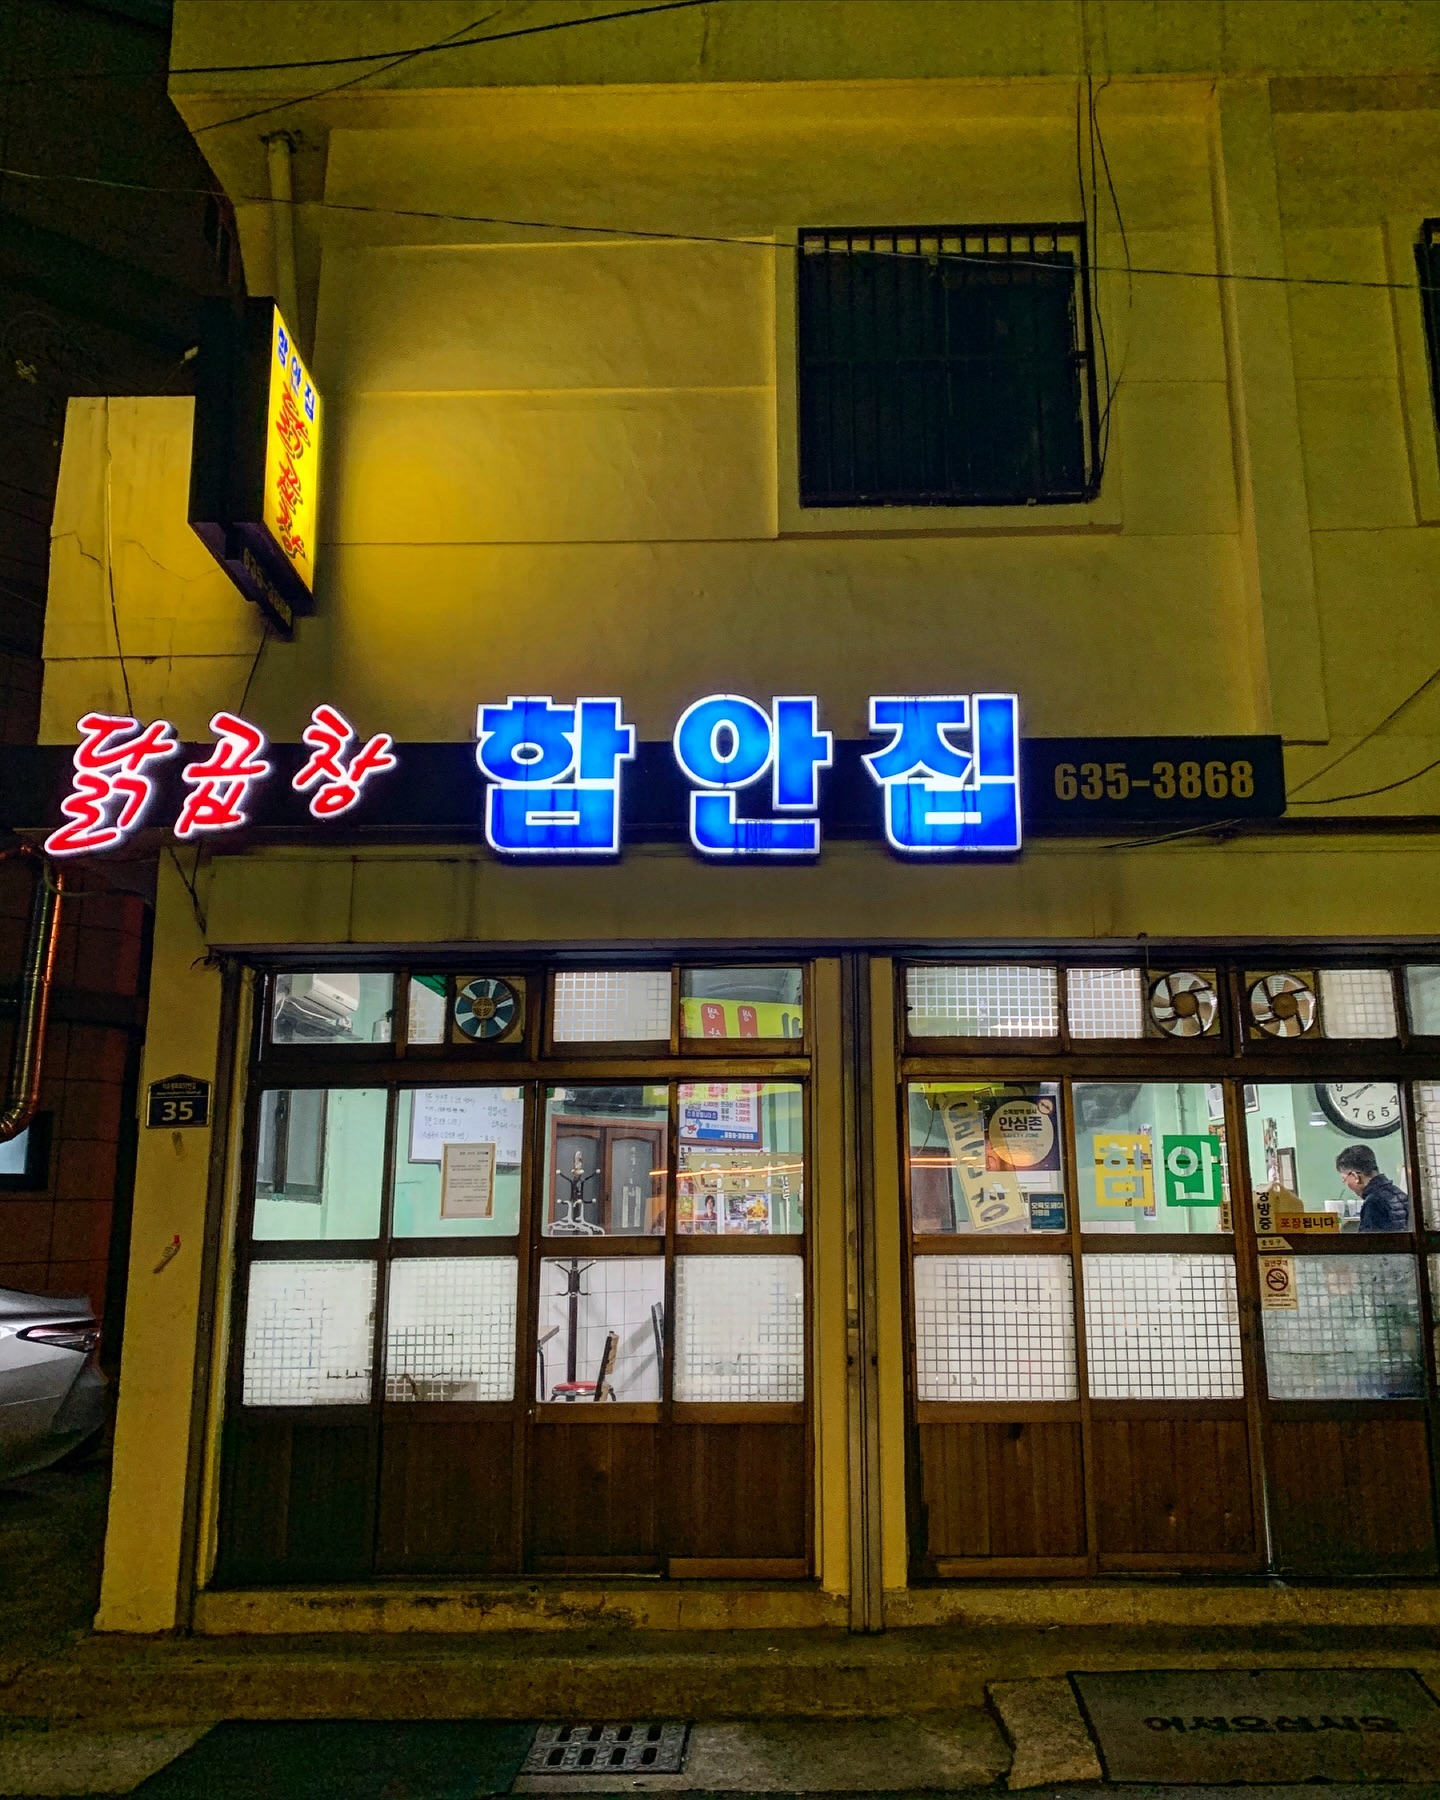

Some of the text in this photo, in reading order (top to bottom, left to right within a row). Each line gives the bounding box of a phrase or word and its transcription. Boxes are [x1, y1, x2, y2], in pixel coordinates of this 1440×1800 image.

[45, 705, 397, 857] 닭곱창
[475, 693, 1022, 856] 함안집
[1054, 760, 1255, 801] 635-3868
[1340, 1096, 1348, 1107] 8
[1389, 1095, 1399, 1106] 4
[161, 1100, 194, 1122] 35
[1353, 1107, 1360, 1118] 7
[1367, 1110, 1376, 1121] 6
[1381, 1106, 1390, 1117] 5
[998, 1116, 1043, 1132] 안심존
[1281, 1216, 1335, 1229] 포장됩니다
